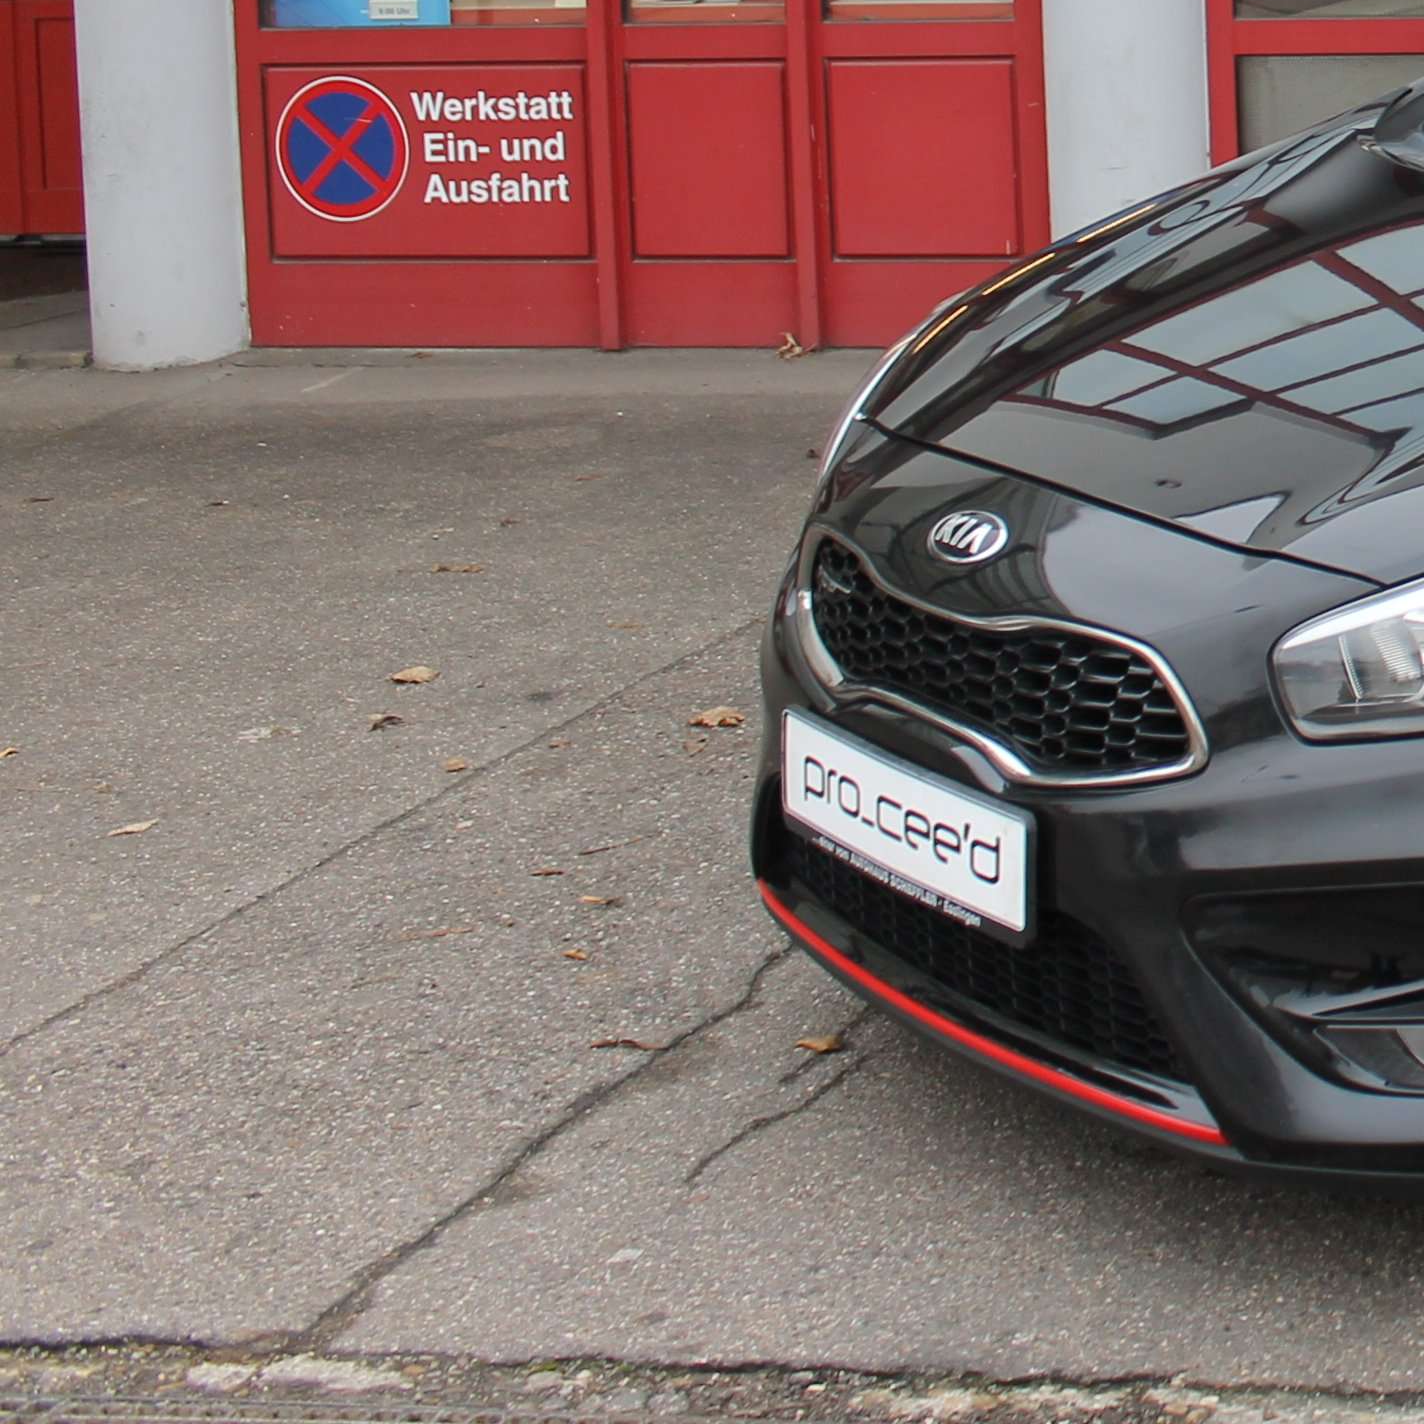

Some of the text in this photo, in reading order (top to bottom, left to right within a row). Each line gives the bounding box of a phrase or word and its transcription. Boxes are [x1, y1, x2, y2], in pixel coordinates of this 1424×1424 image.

[410, 91, 573, 121] Werkstatt
[423, 131, 565, 162] Ein- und
[423, 173, 570, 203] Ausfahrt
[935, 515, 993, 554] KIA
[804, 755, 1001, 885] pro_cee'd
